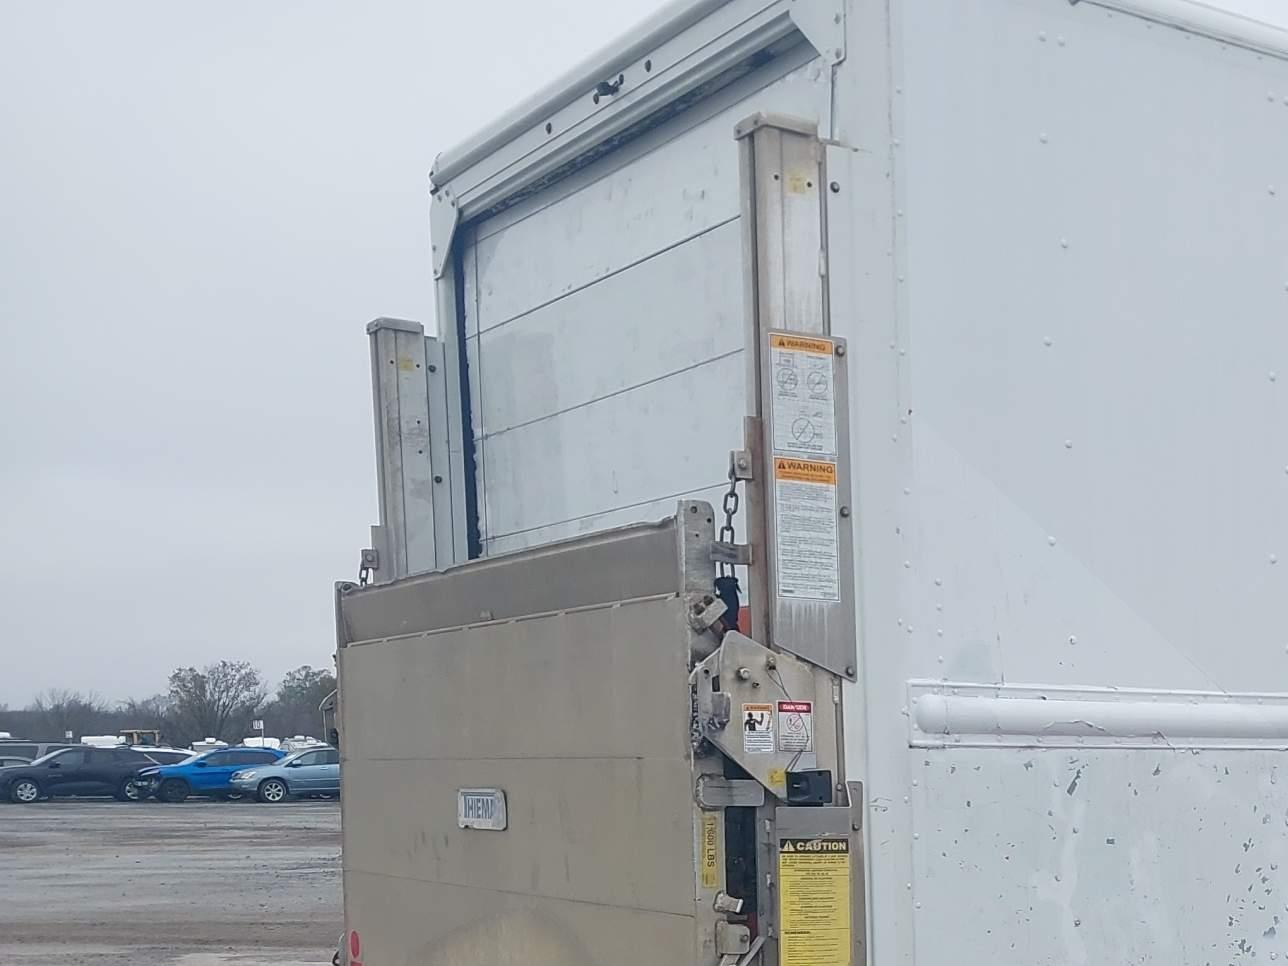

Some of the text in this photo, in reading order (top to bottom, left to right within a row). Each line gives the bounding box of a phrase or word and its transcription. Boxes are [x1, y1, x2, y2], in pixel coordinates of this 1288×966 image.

[787, 461, 833, 473] WARNING
[796, 841, 847, 851] CAUTION
[706, 848, 716, 868] LBS
